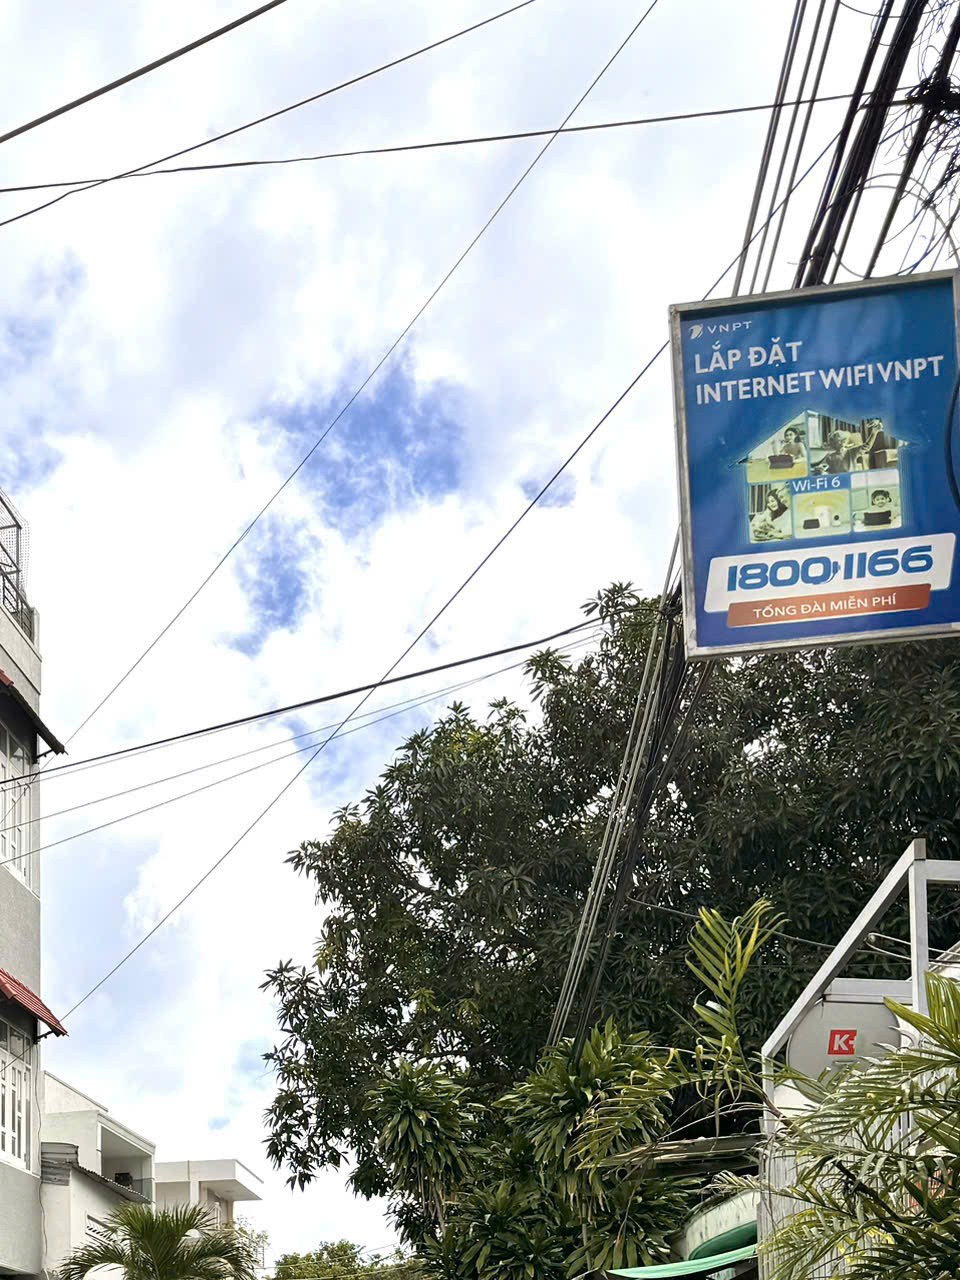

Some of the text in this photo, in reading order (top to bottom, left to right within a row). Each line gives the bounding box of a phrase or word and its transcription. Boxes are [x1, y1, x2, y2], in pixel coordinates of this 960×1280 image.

[707, 321, 752, 334] VNPT
[694, 336, 803, 374] LẮP ĐẶT
[696, 354, 944, 405] INTERNET WIFI VNPT
[792, 476, 841, 492] Wi-Fi 6
[800, 600, 826, 614] ĐÀI
[830, 595, 868, 611] MIỄN
[872, 592, 897, 607] PHÍ
